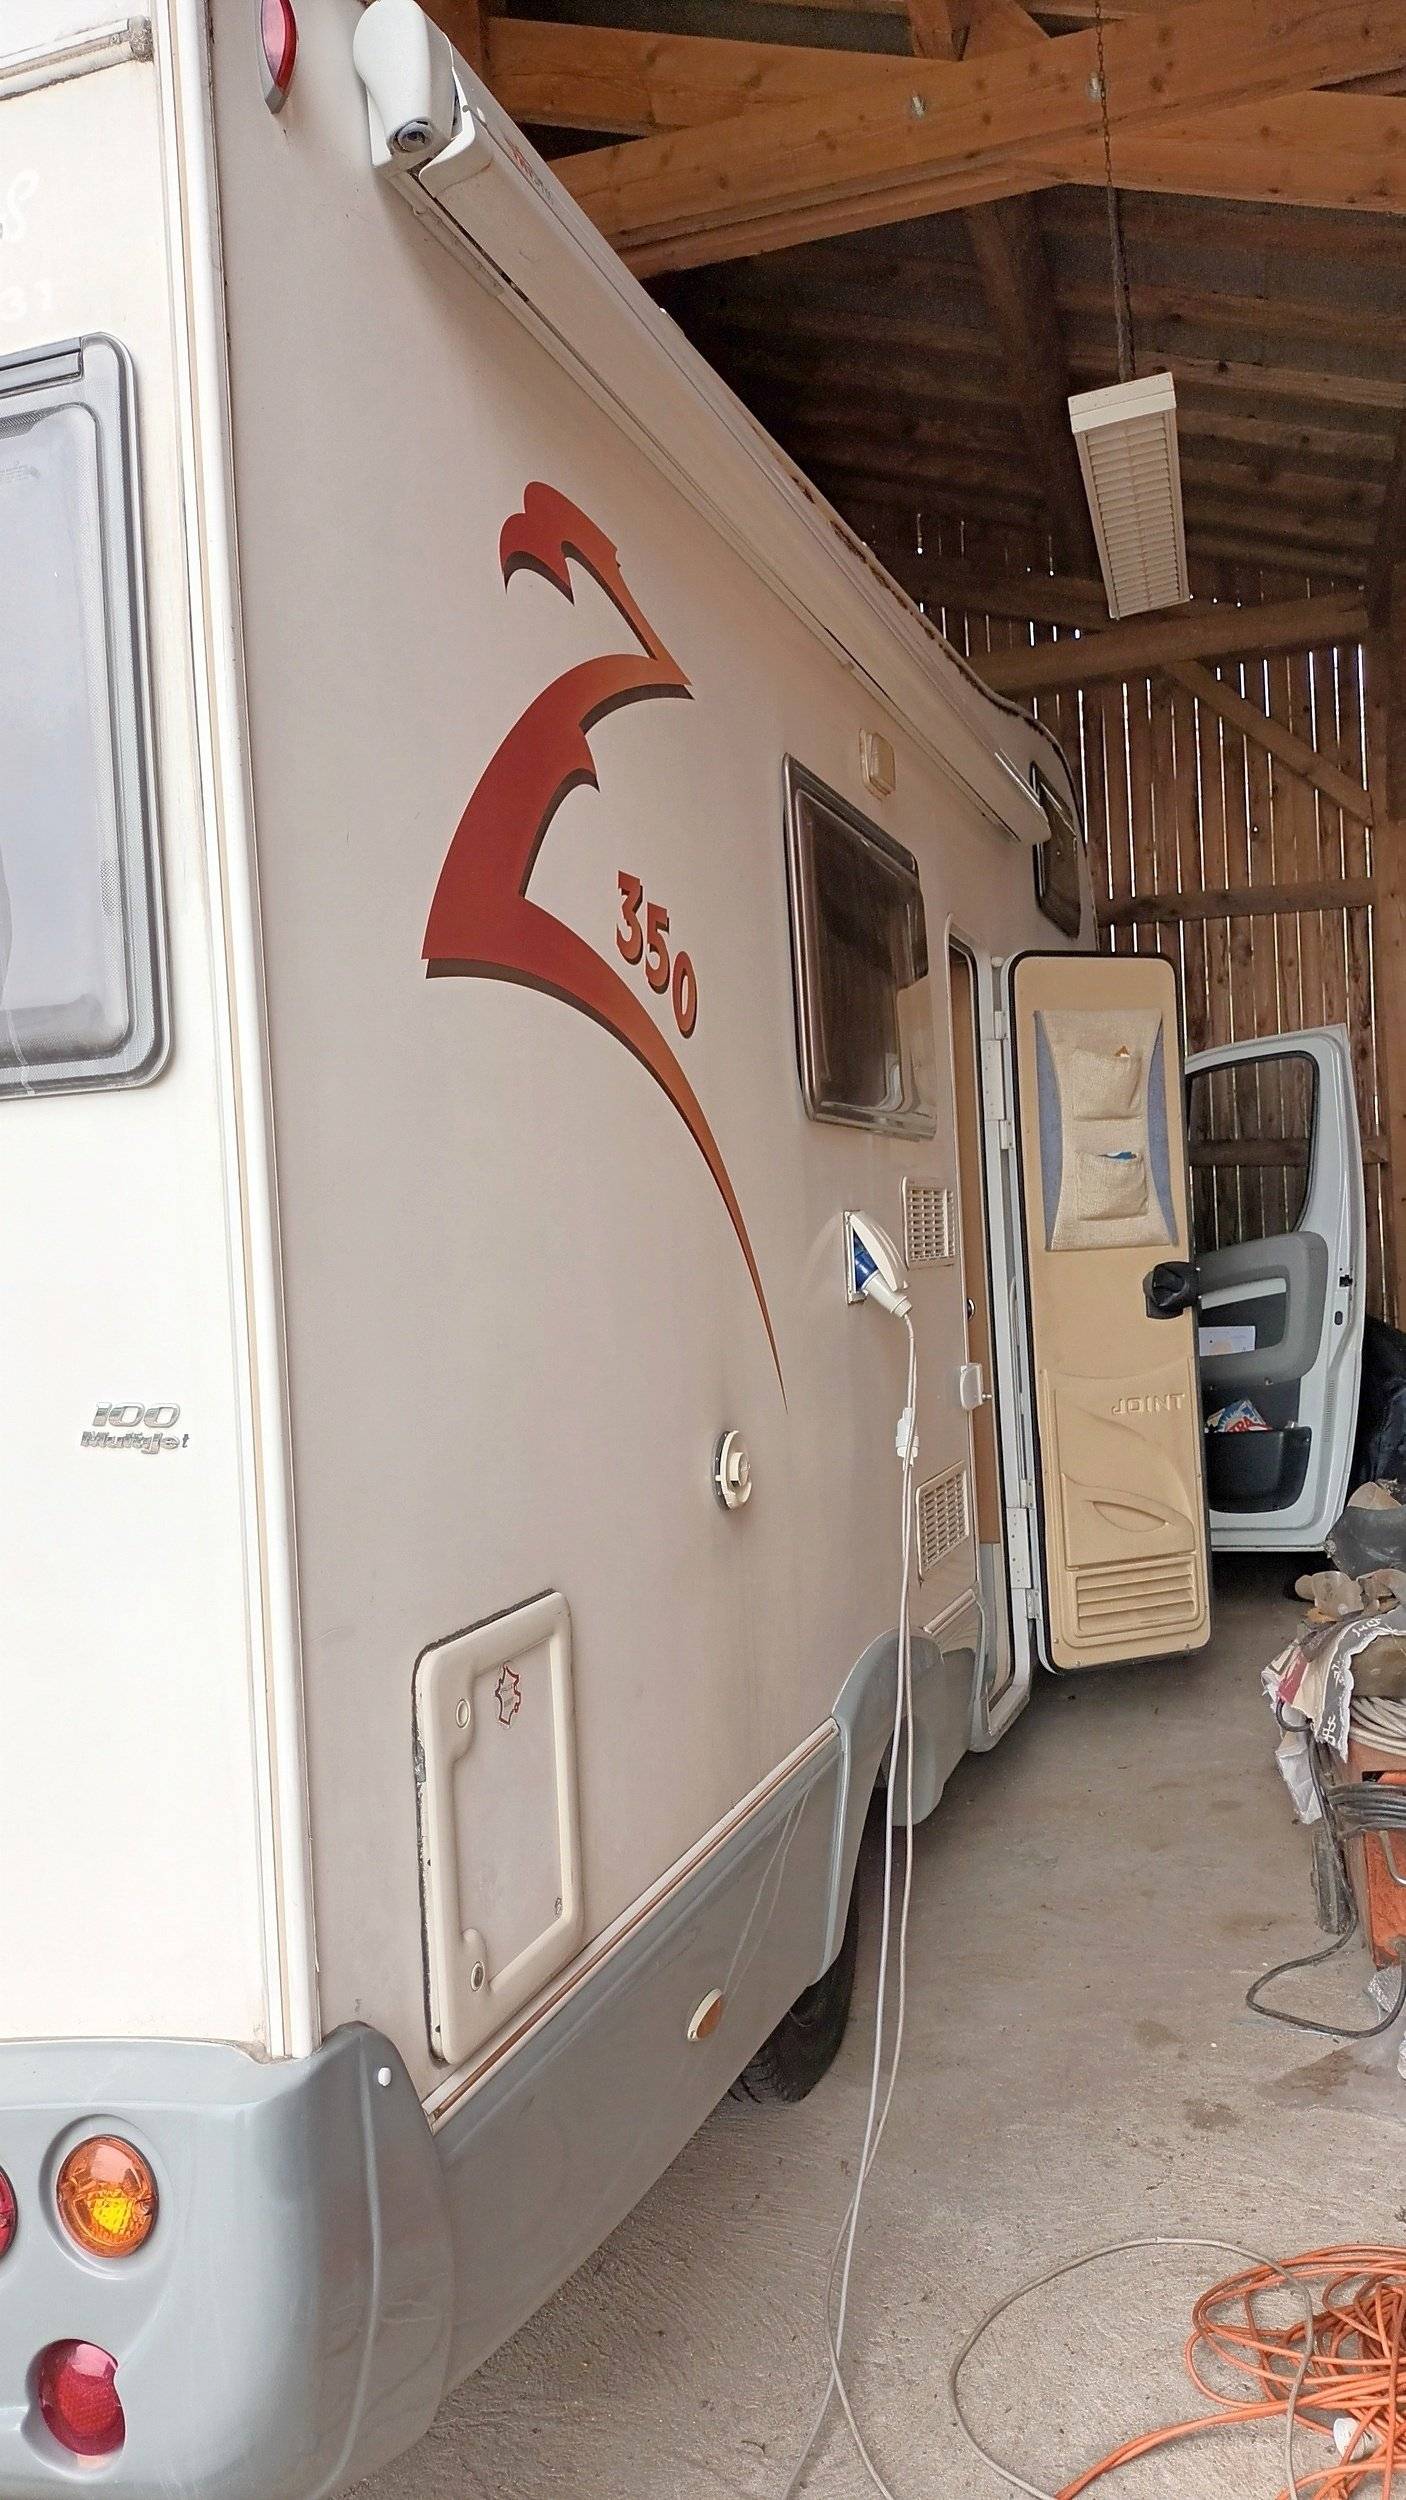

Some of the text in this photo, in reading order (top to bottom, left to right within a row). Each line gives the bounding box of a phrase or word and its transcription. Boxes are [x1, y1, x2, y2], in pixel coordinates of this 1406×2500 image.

[616, 869, 698, 1040] 350
[92, 1401, 181, 1428] 100
[1111, 1392, 1185, 1415] JOINT
